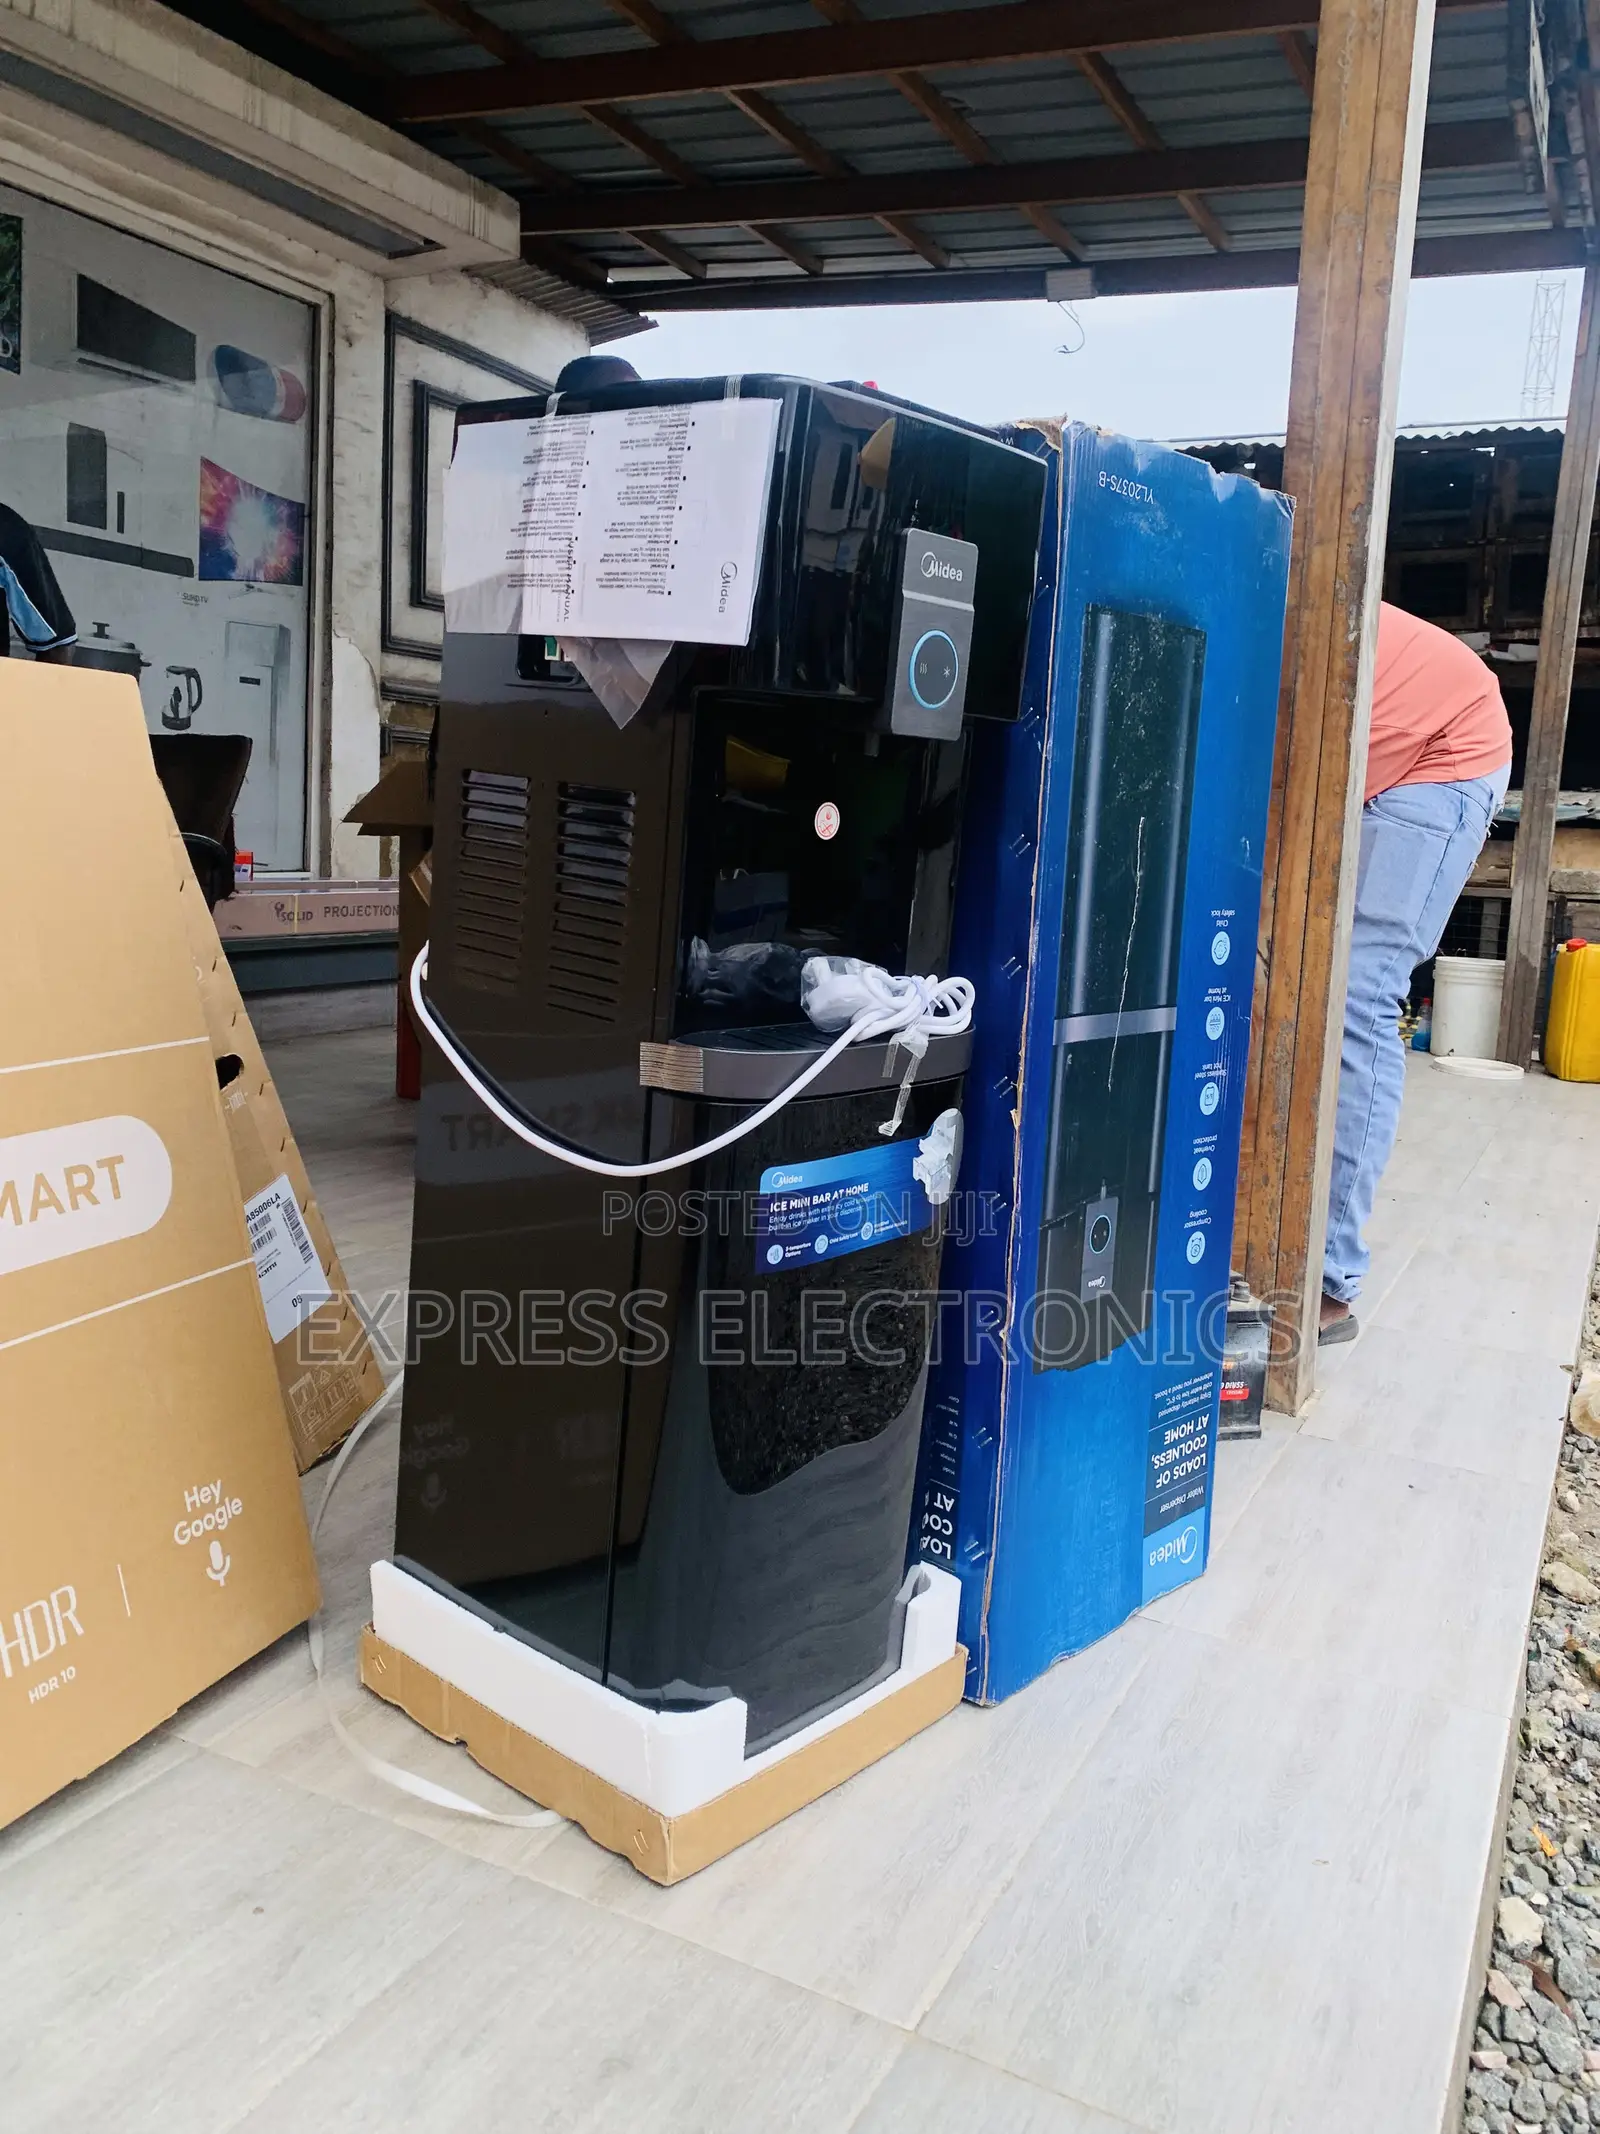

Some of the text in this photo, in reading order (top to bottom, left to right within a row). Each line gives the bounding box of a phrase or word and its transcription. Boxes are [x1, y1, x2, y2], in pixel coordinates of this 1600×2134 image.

[1098, 470, 1154, 505] YL2037S-B
[920, 551, 963, 582] Midea
[718, 561, 738, 613] Midea
[281, 910, 314, 922] SOLID
[1210, 908, 1236, 918] safety lock
[1215, 919, 1229, 927] Child
[1192, 1133, 1218, 1146] protection
[1193, 1144, 1216, 1155] Overheat
[771, 1171, 803, 1188] Midea
[245, 1192, 281, 1224] A85006LA
[769, 1182, 869, 1213] ICE MINI BAR AT HOME
[769, 1214, 787, 1225] Enjoy
[788, 1210, 807, 1220] drinks
[808, 1207, 820, 1216] with
[792, 1219, 802, 1228] ice
[802, 1216, 820, 1226] maker
[1183, 1216, 1212, 1229] Compressor
[1189, 1208, 1208, 1219] cooling
[1163, 1413, 1210, 1446] AT HOME
[1151, 1433, 1208, 1470] COOLNESS,
[1155, 1452, 1207, 1489] LOADS OF
[183, 1479, 221, 1512] Hey
[933, 1491, 955, 1513] AT
[1159, 1485, 1205, 1513] Water Dispenser
[173, 1496, 243, 1546] Google
[1149, 1525, 1198, 1566] Midea
[0, 1584, 84, 1679] HDR
[28, 1665, 76, 1705] HDR 10
